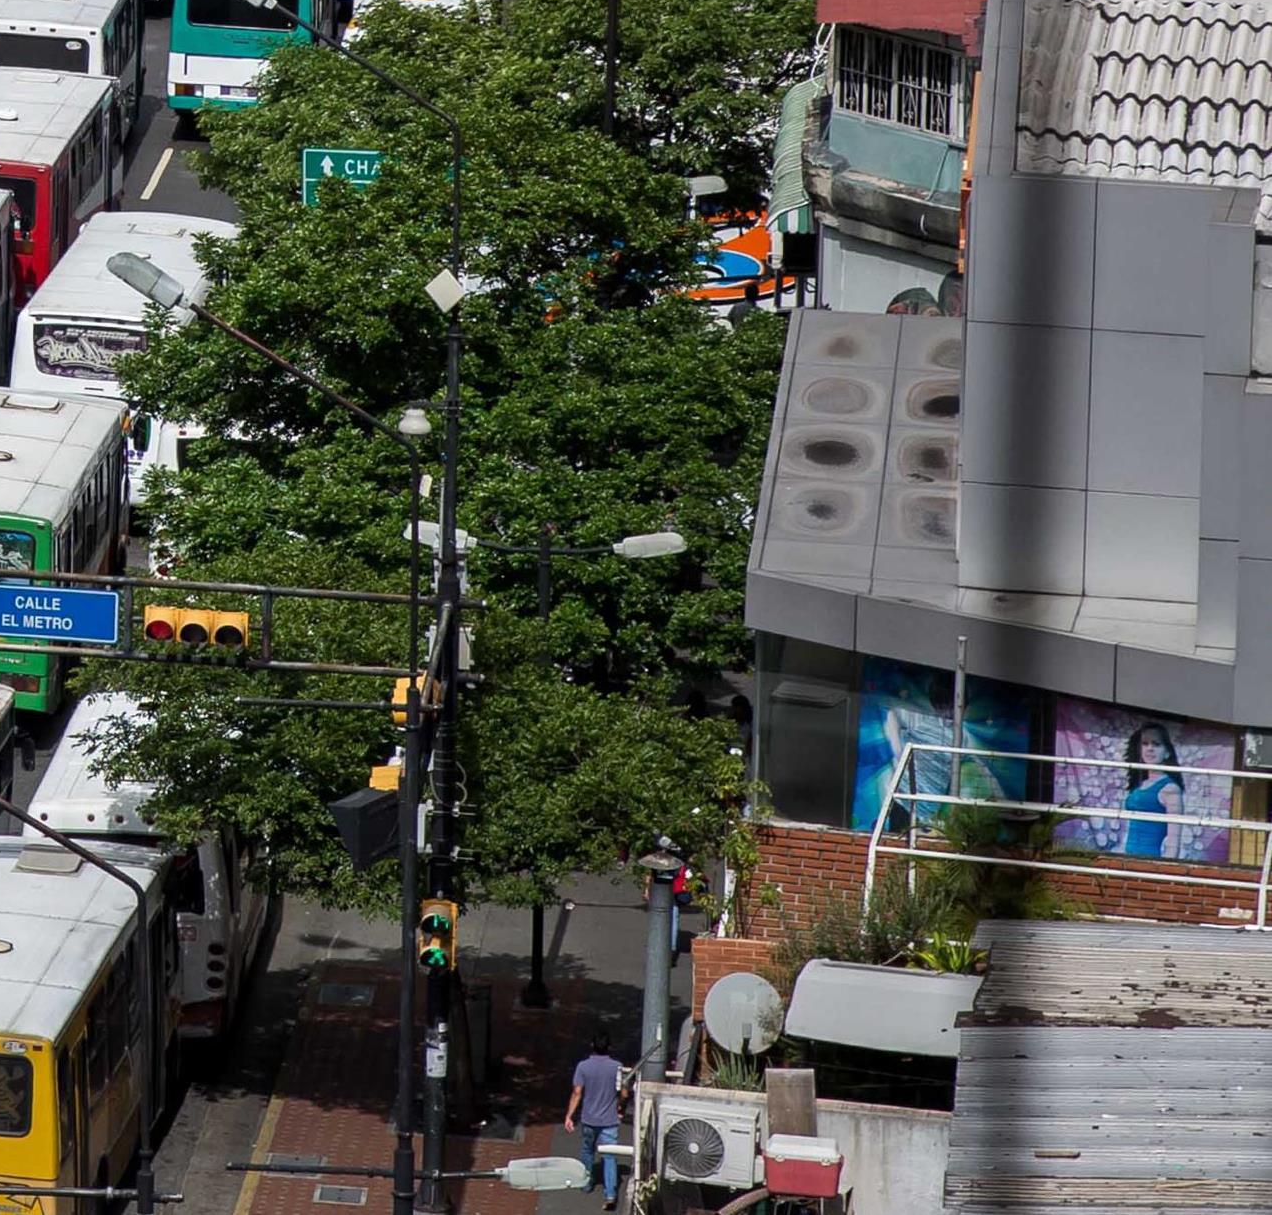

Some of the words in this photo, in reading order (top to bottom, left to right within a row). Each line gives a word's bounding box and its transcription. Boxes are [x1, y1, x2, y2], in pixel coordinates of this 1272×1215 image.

[15, 595, 62, 611] CALLE
[1, 614, 19, 628] EL
[23, 615, 73, 631] METRO
